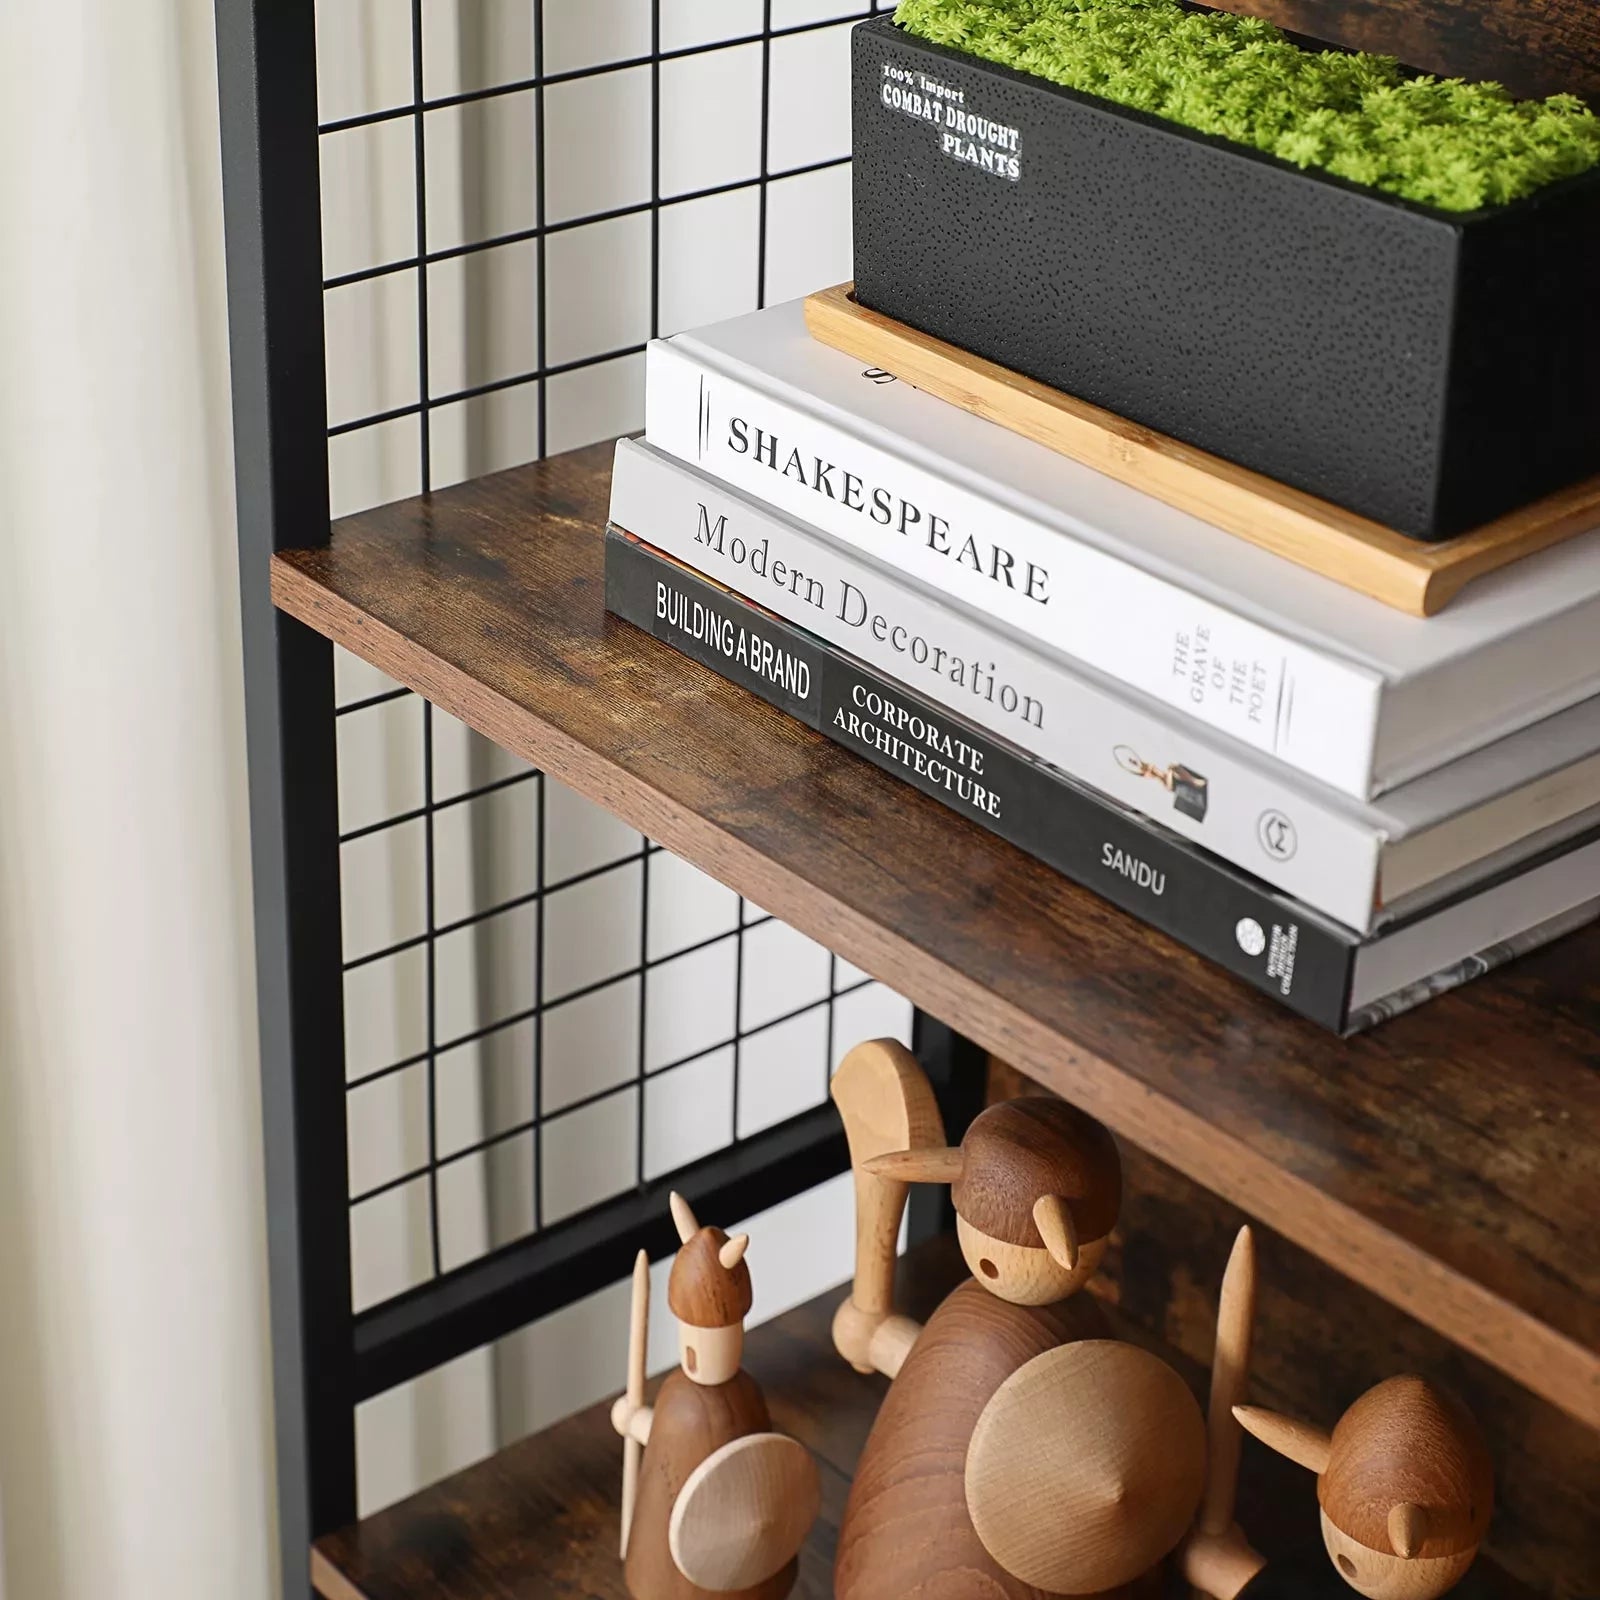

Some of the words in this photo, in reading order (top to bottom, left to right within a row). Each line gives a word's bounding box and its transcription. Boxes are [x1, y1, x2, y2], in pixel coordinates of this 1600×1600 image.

[882, 83, 942, 123] COMBAT
[945, 106, 1019, 151] DROUGHT
[920, 75, 965, 104] Import
[942, 132, 1020, 178] PLANTS
[727, 416, 1052, 606] SHAKESPEARE
[656, 581, 734, 657] BUILDING
[735, 627, 749, 667] A
[750, 633, 811, 700] BRAND
[693, 502, 826, 611] Modern
[835, 578, 1046, 730] Decoration
[1173, 632, 1190, 676] THE
[1190, 623, 1210, 704] GRAVE
[1211, 655, 1226, 689] OF
[1229, 659, 1248, 704] THE
[1248, 660, 1267, 724] POET
[851, 683, 985, 776] CORPORATE
[832, 706, 1002, 820] ARCHITECTURE
[1101, 841, 1167, 896] SANDU
